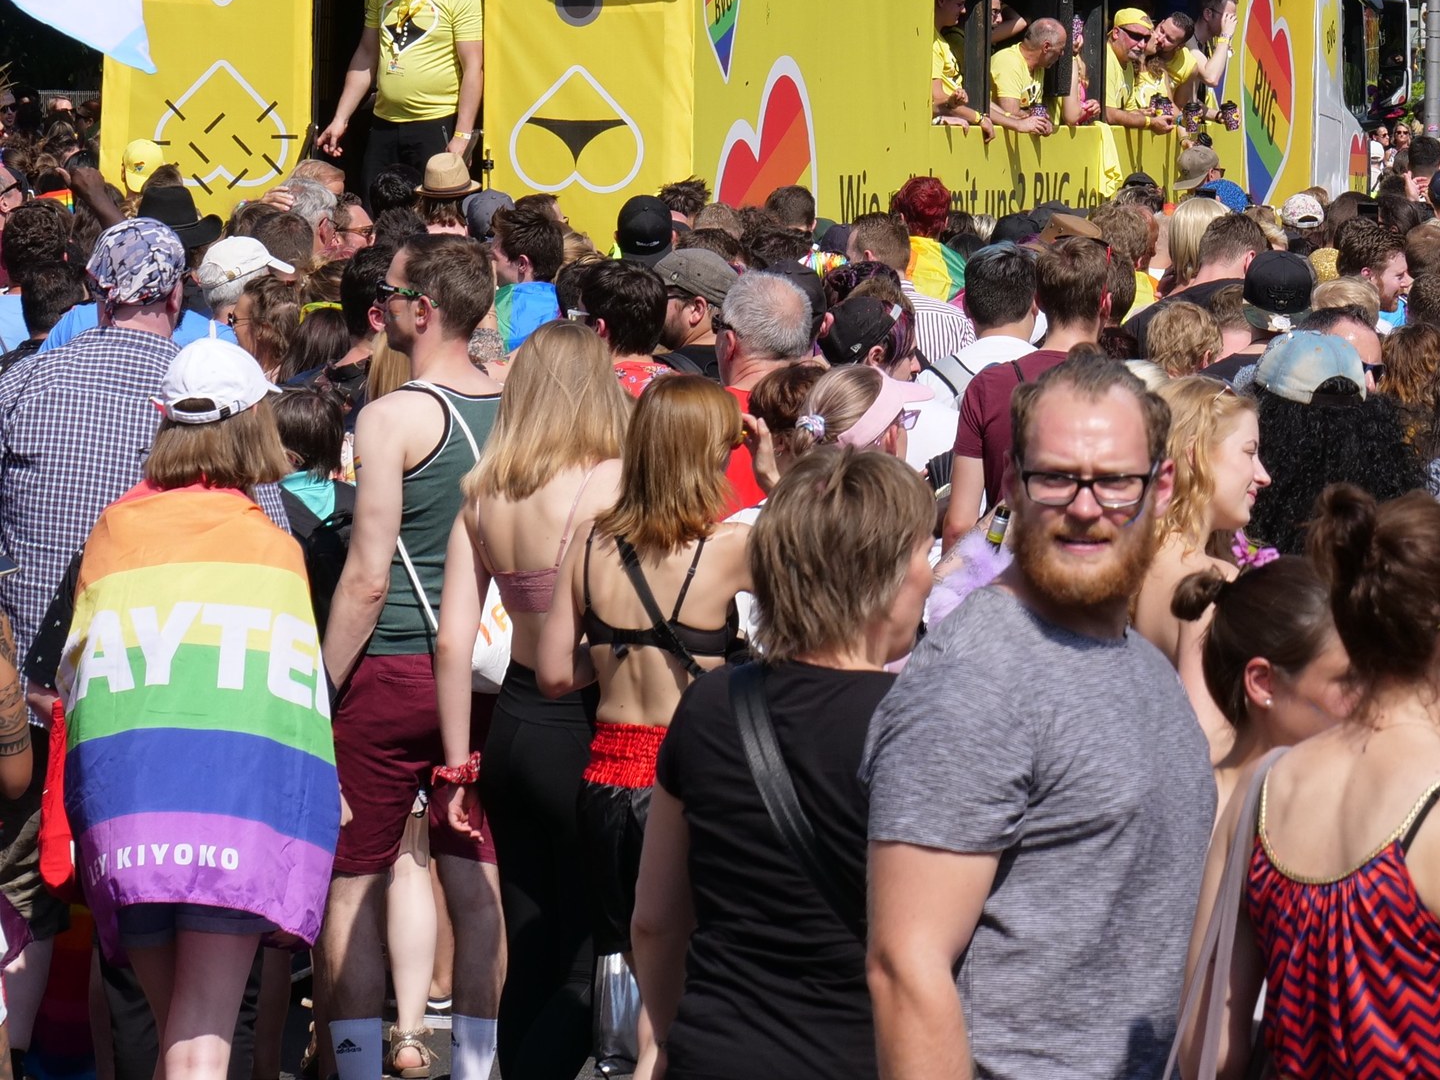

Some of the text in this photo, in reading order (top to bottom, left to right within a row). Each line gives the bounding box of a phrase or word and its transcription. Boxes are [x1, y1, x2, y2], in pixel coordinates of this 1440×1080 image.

[1252, 58, 1278, 146] BVG
[1034, 172, 1070, 210] BVG
[117, 843, 239, 871] KIYOKO
